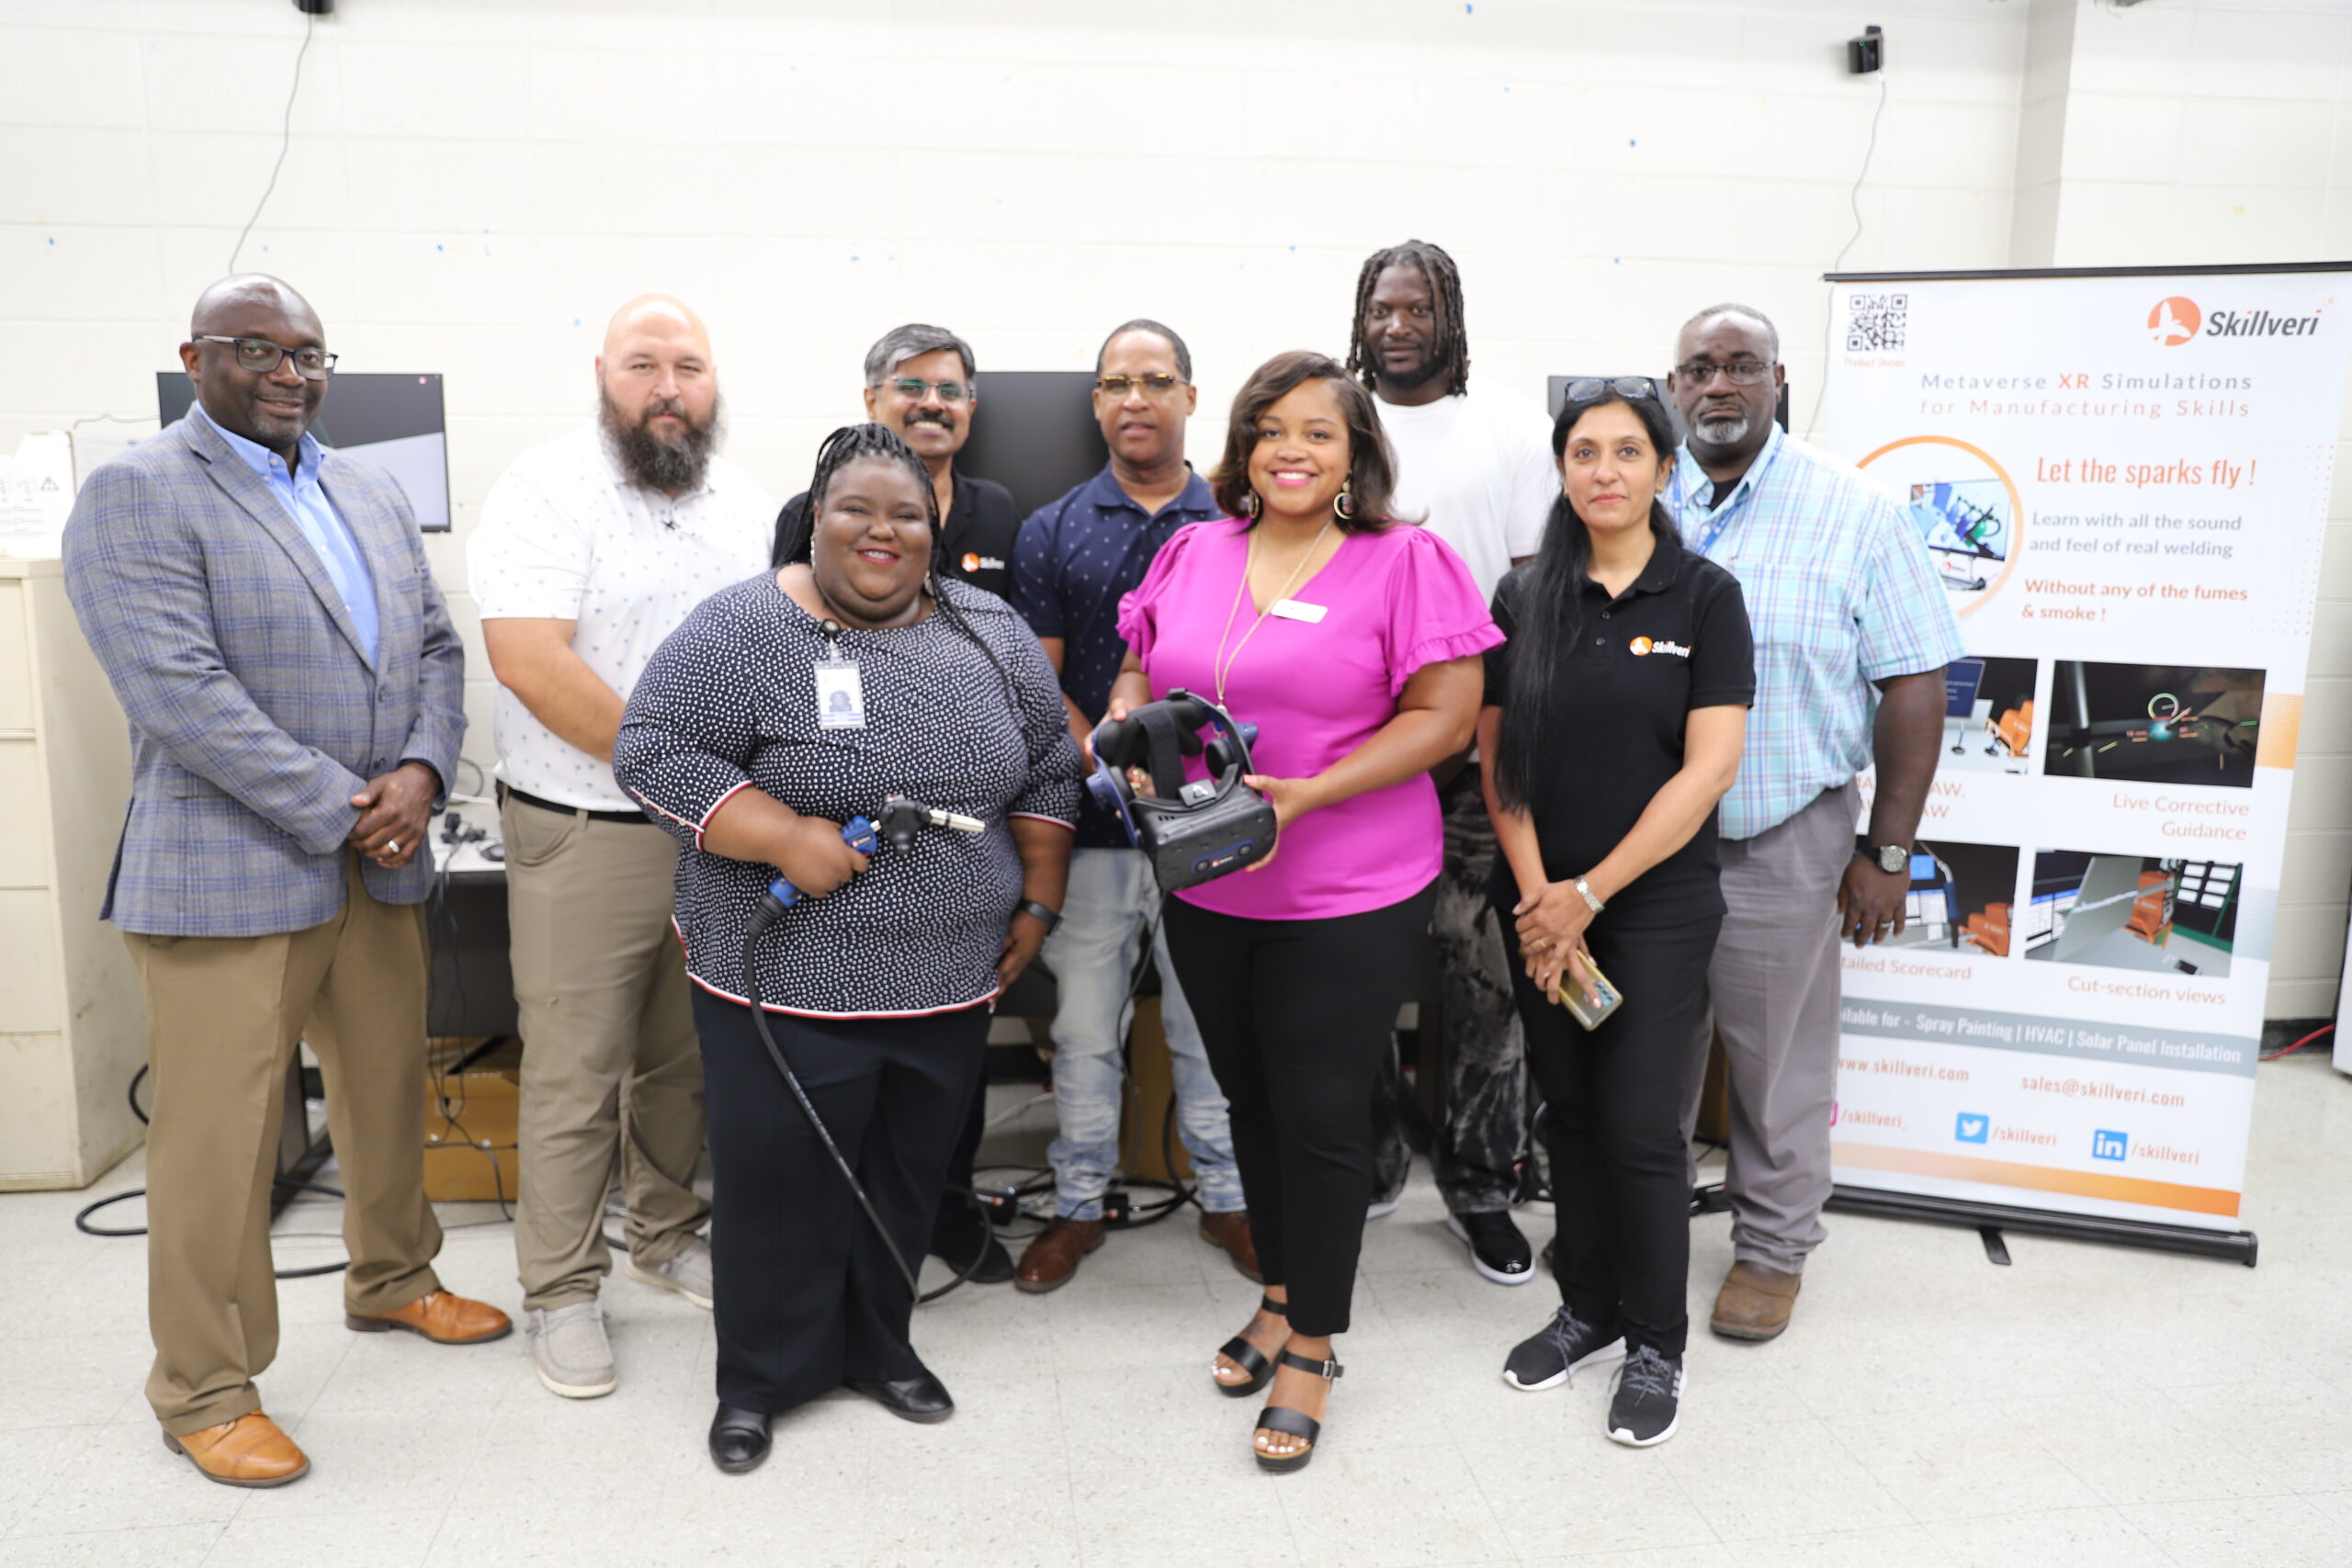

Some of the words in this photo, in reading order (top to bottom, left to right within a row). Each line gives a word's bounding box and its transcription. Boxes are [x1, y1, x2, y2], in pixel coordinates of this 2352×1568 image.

[2206, 310, 2321, 336] Skillveri
[1922, 374, 2046, 389] Metaverse
[2058, 374, 2089, 389] XR
[2102, 373, 2251, 389] Simulations
[1921, 400, 1955, 414] for
[1970, 400, 2161, 420] Manufacturing
[2177, 400, 2248, 416] Skills
[2037, 457, 2071, 482] Let
[2081, 458, 2117, 483] the
[2125, 458, 2201, 489] sparks
[2211, 459, 2242, 489] fly
[2032, 512, 2079, 526] Learn
[2086, 513, 2123, 527] with
[2129, 513, 2149, 527] all
[2154, 514, 2182, 529] the
[2188, 515, 2242, 530] sound
[2030, 537, 2061, 551] and
[2067, 538, 2098, 552] feel
[2104, 539, 2120, 553] of
[2126, 540, 2159, 554] real
[2165, 541, 2233, 559] welding
[2025, 580, 2095, 595] Without
[2100, 586, 2132, 599] any
[2137, 583, 2155, 597] of
[2161, 584, 2188, 599] the
[2195, 585, 2247, 601] fumes
[2022, 604, 2033, 617] &
[2041, 606, 2095, 621] smoke
[2113, 794, 2149, 810] Live
[2155, 796, 2249, 817] Corrective
[2162, 821, 2246, 840] Guidance
[1840, 955, 1884, 973] tailed
[1889, 958, 1973, 980] Scorecard
[2068, 976, 2170, 999] Cut-section
[2177, 987, 2225, 1005] views
[1841, 1007, 1878, 1025] ilable
[1882, 1011, 1901, 1027] for
[1917, 1014, 1955, 1035] Spray
[1958, 1018, 2013, 1042] Painting
[2025, 1025, 2065, 1044] HVAC
[2076, 1031, 2114, 1050] Solar
[2117, 1035, 2157, 1055] Panel
[2161, 1041, 2241, 1063] Installation
[2021, 1076, 2185, 1108] sales@skillveri.com
[1992, 1126, 2057, 1146] /skillveri
[2132, 1144, 2199, 1165] /skillveri
